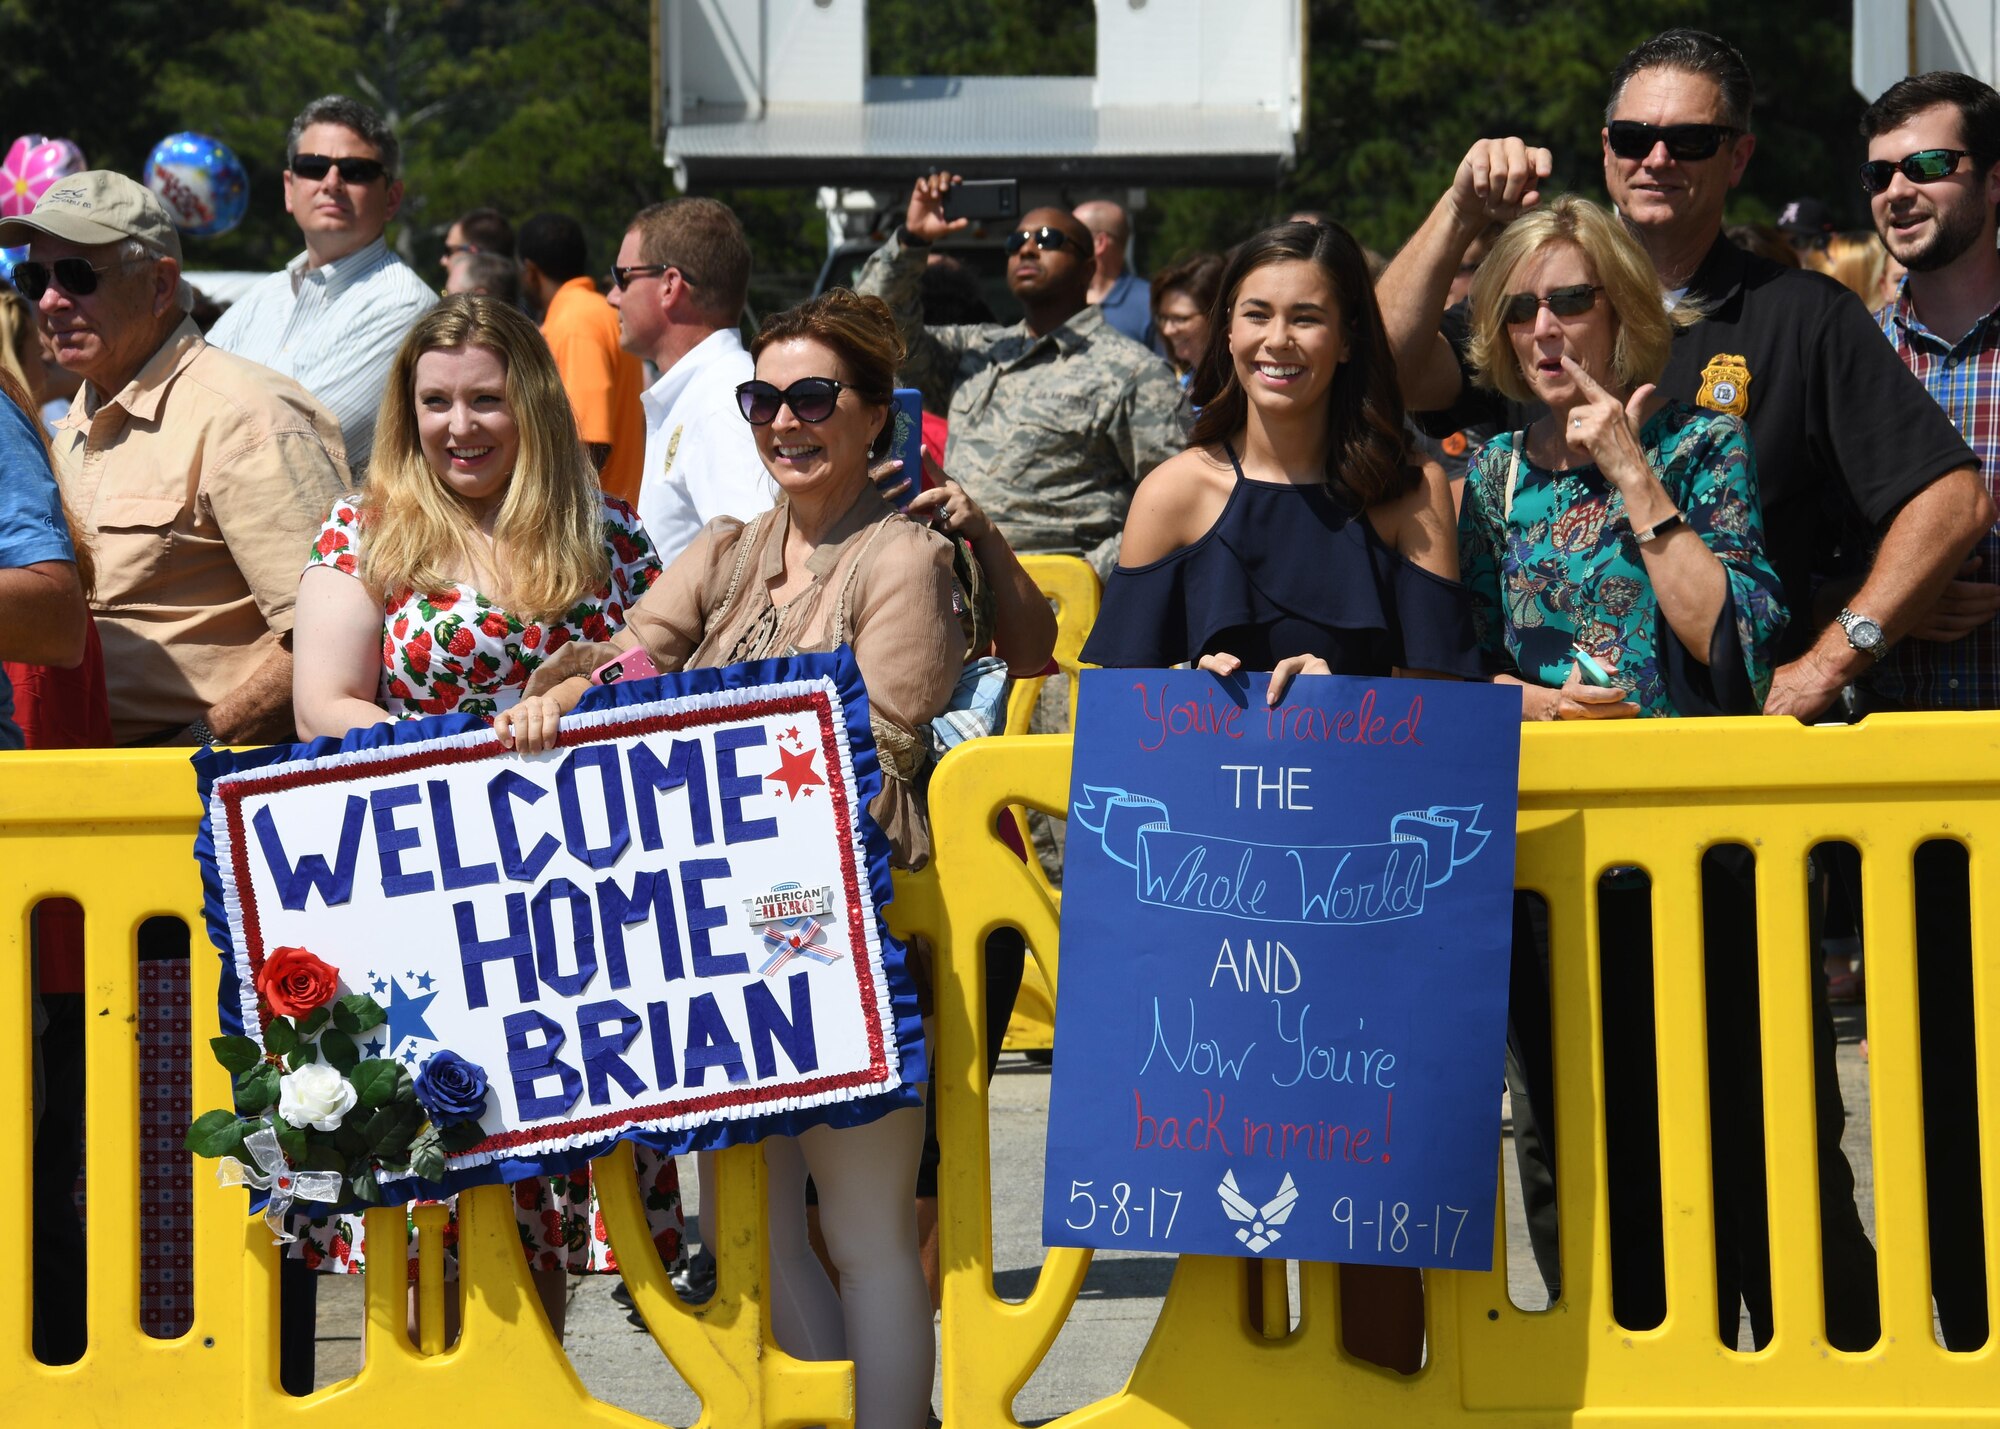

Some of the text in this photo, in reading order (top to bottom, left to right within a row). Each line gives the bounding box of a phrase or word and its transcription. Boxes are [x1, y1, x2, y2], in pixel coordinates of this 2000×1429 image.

[1134, 682, 1424, 752] You've traveled
[252, 725, 778, 911] WELCOME
[1221, 764, 1314, 811] THE
[755, 888, 820, 905] AMERICAN
[762, 898, 814, 919] HERO
[1139, 835, 1423, 919] Whole World
[452, 857, 750, 1009] HOME
[1210, 938, 1302, 994] AND
[502, 972, 819, 1121] BRIAN
[1139, 996, 1396, 1088] Now You're
[1134, 1089, 1233, 1156] back
[1066, 1180, 1183, 1239] 5-8-17
[1332, 1197, 1469, 1258] 9-18-17
